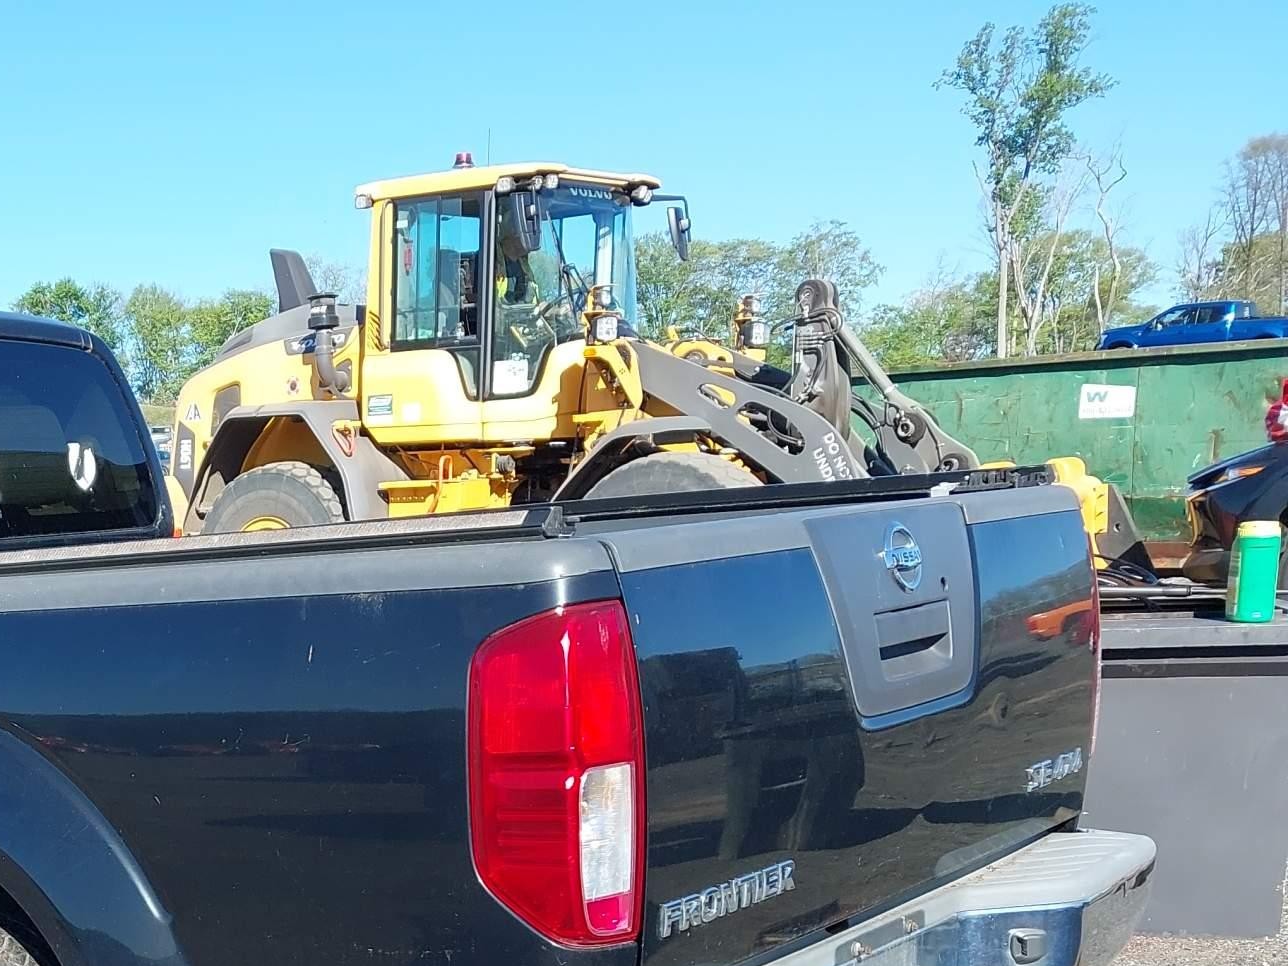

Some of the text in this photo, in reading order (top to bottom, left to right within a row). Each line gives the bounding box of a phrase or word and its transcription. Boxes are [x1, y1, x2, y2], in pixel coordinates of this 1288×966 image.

[569, 187, 613, 200] VOLVO
[823, 431, 854, 480] DO NO
[658, 859, 797, 939] FRONTIER
